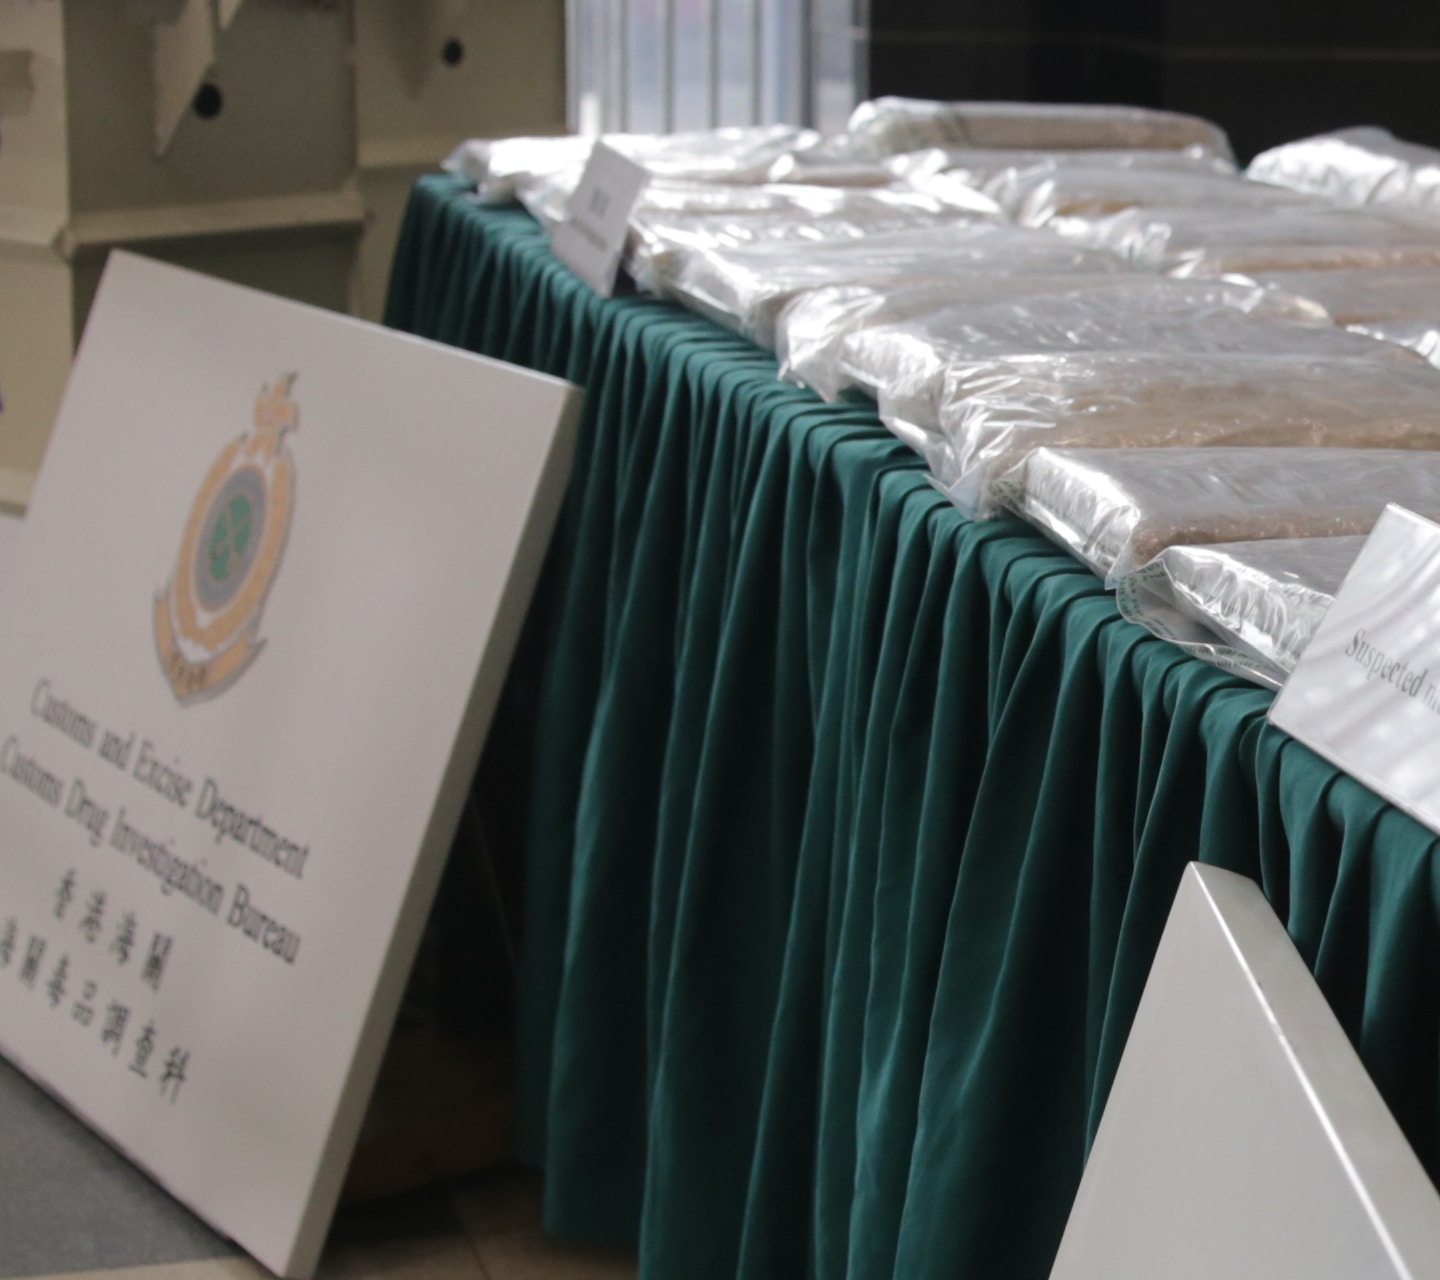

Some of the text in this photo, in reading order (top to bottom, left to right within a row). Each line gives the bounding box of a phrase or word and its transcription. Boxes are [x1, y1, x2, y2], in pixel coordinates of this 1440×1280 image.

[1344, 627, 1428, 698] Suspected
[30, 677, 309, 880] Customs and Excise Department
[64, 777, 109, 848] Drug
[109, 806, 224, 916] Investigation
[226, 882, 302, 966] Bureau
